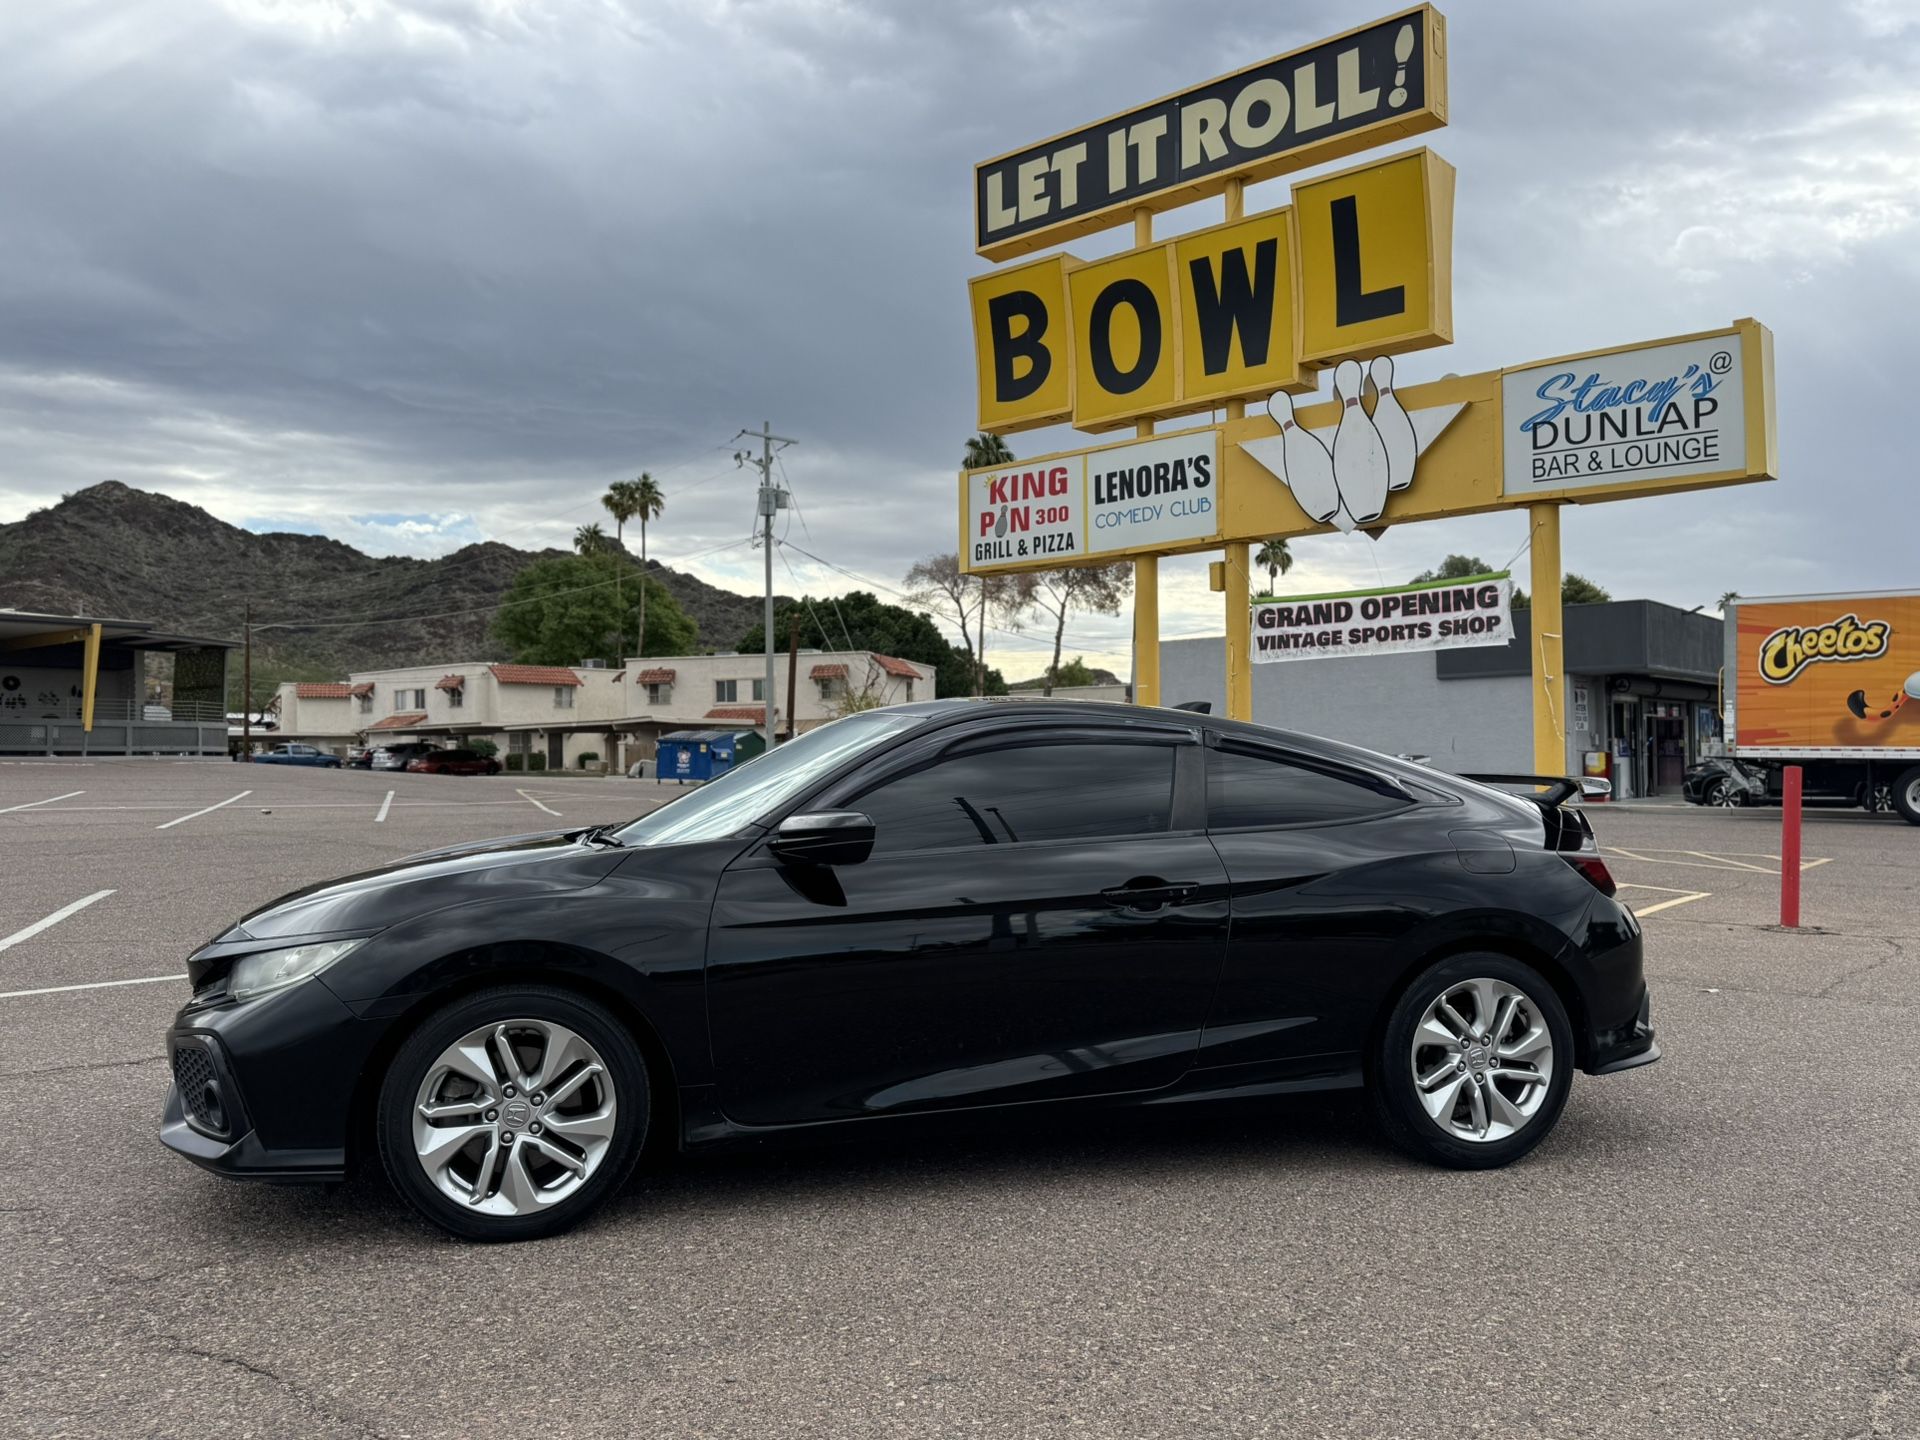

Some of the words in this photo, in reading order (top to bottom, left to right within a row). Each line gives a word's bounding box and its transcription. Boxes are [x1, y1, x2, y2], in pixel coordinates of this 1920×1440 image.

[986, 142, 1088, 233] LET
[1108, 114, 1168, 195] IT
[1181, 23, 1416, 171] ROLL!
[988, 194, 1406, 404] BOWL
[1520, 364, 1723, 432] Stacy's
[1709, 351, 1733, 375] @
[1532, 397, 1718, 450] DUNLAP
[1094, 454, 1211, 505] LENORA'S
[1533, 453, 1581, 479] BAR
[1587, 450, 1604, 472] &
[1610, 435, 1719, 469] LOUNGE
[989, 466, 1069, 505] KING
[1035, 505, 1070, 526] 300
[1095, 504, 1164, 530] COMEDY
[1170, 497, 1212, 518] CLUB
[975, 537, 1014, 562] GRILL
[1017, 538, 1029, 557] &
[1033, 531, 1075, 554] PIZZA
[1257, 601, 1354, 630] GRAND
[1360, 585, 1500, 620] OPENING
[1257, 630, 1343, 651] VINTAGE
[1348, 622, 1432, 645] SPORTS
[1438, 615, 1501, 638] SHOP
[1760, 615, 1888, 681] Cheetos
